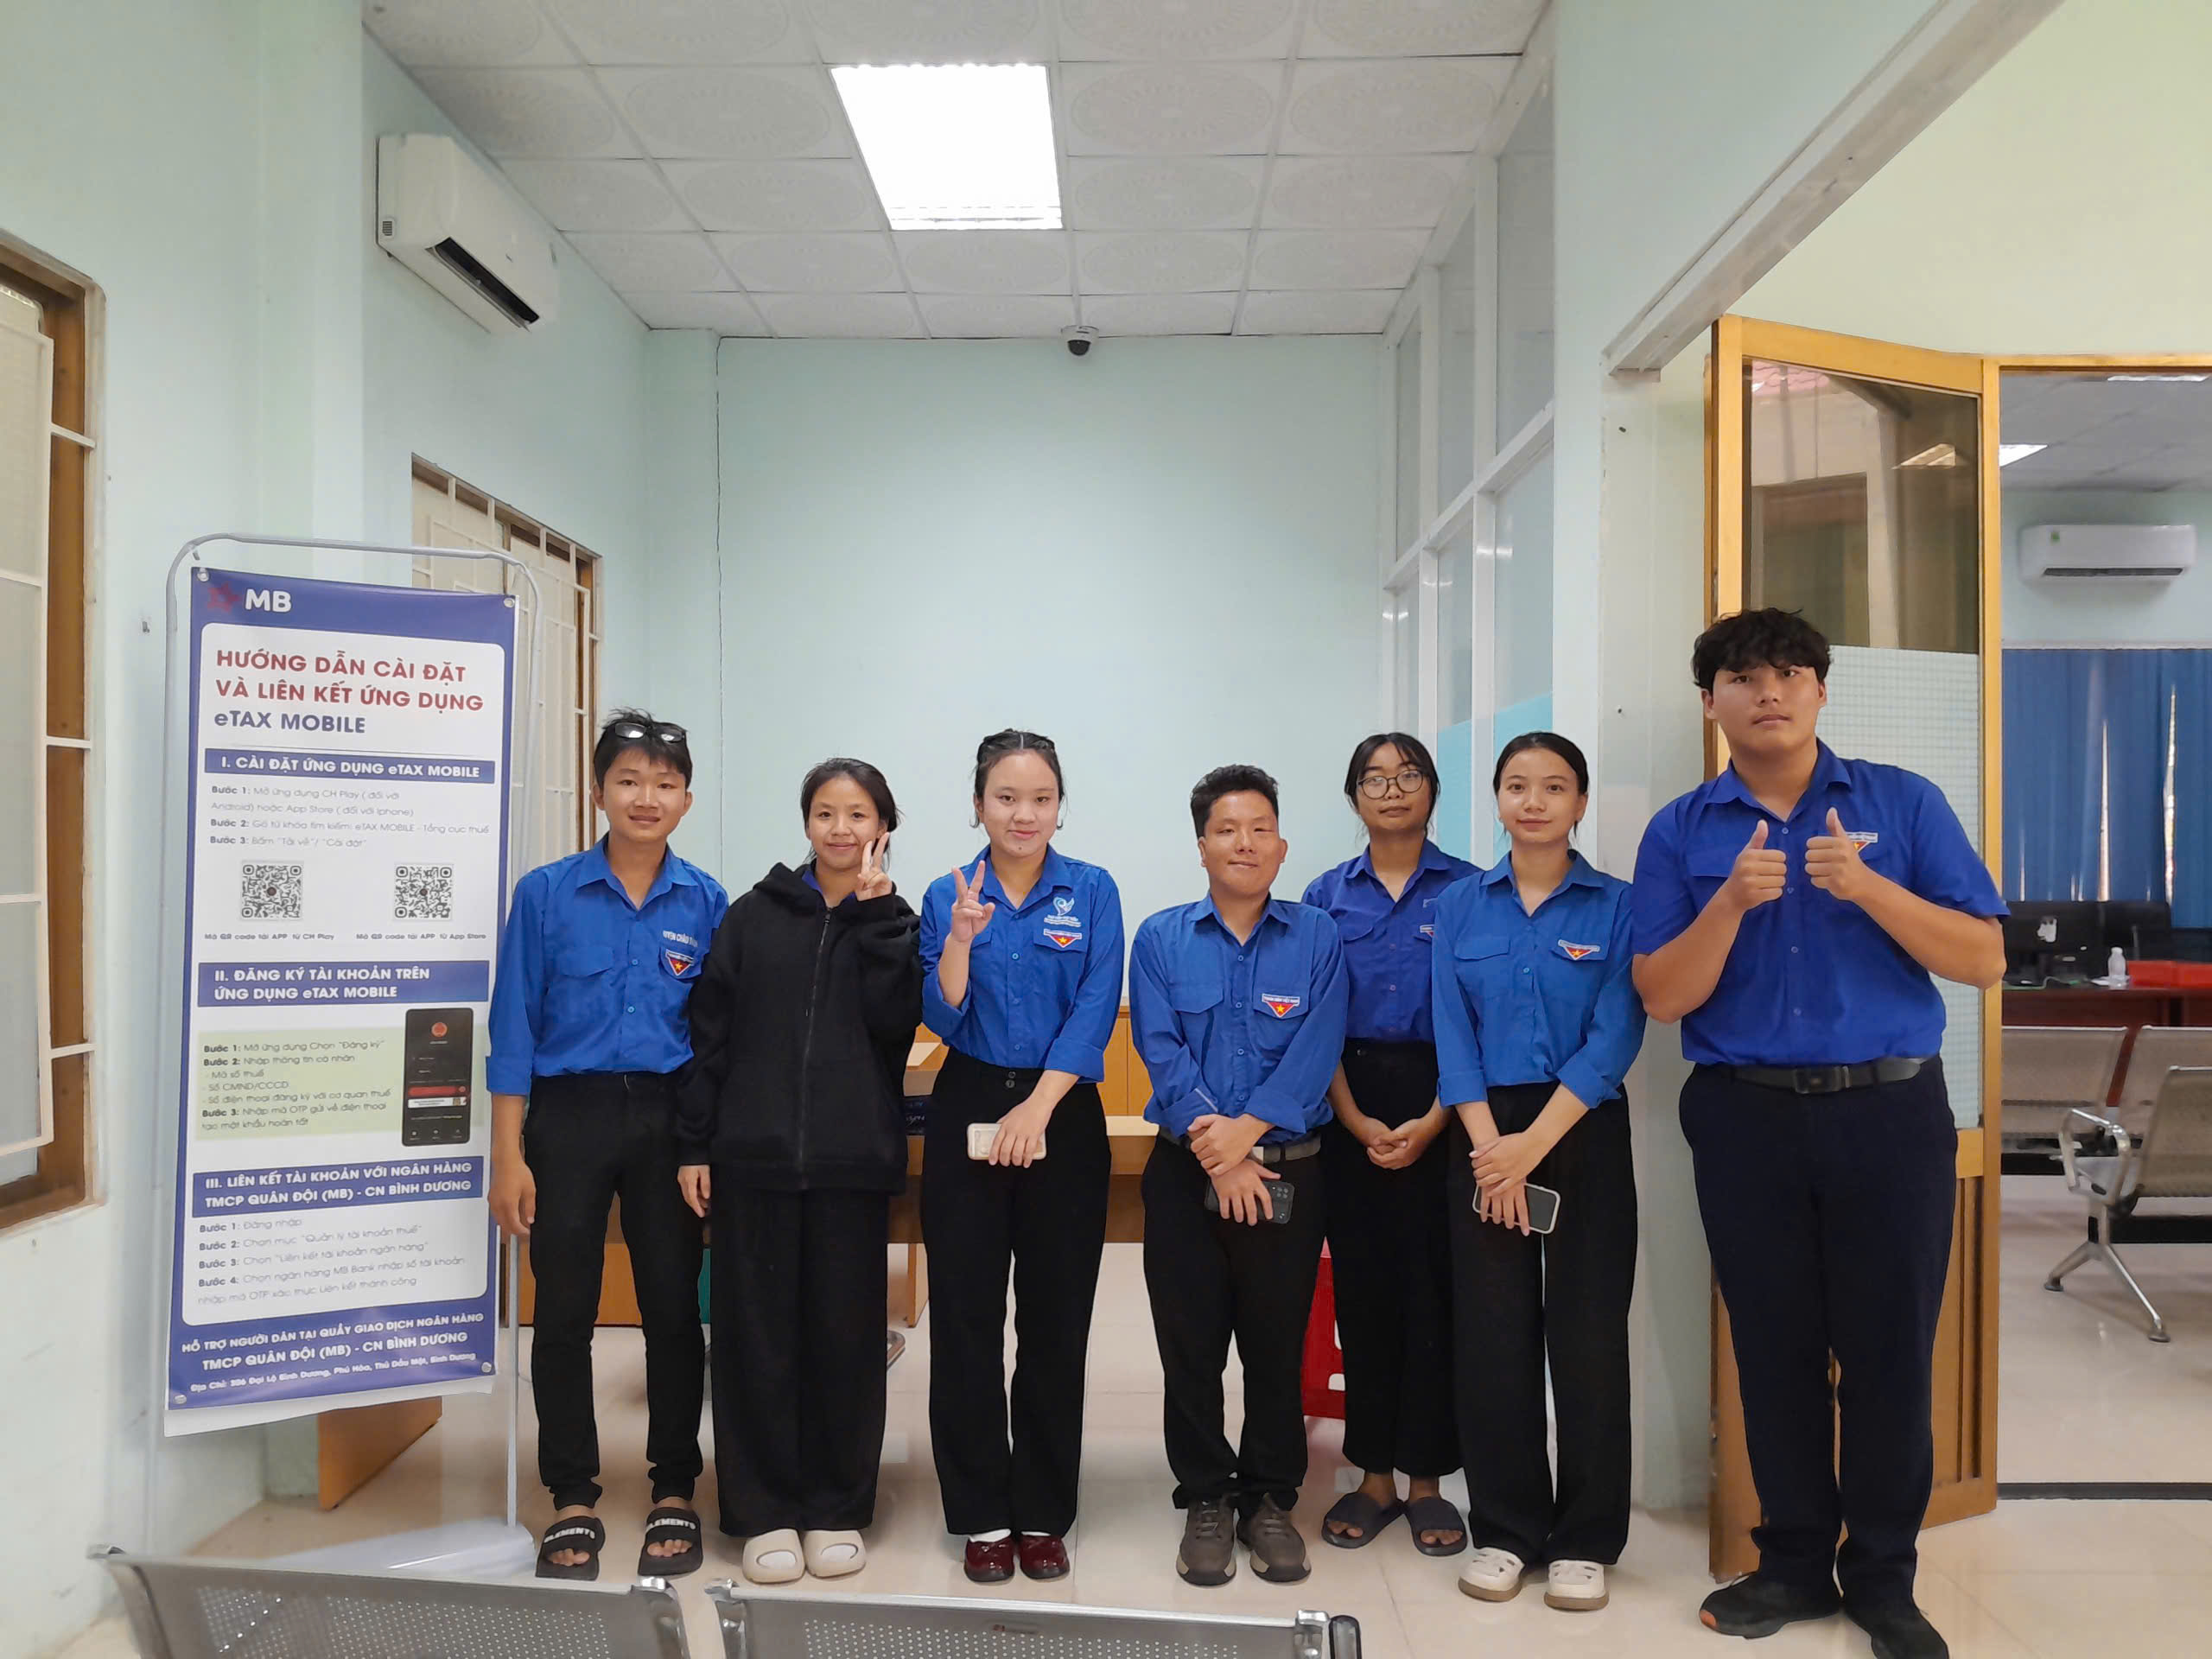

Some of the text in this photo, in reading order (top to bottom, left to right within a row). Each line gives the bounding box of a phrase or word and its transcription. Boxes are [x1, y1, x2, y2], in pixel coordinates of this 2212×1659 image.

[245, 589, 292, 613] MB
[216, 650, 467, 687] HƯỚNG DẪN CÀI ĐẶT
[216, 676, 484, 714] VÀ LIÊN KẾT ỨNG DỤNG
[214, 711, 365, 734] eTAX MOBILE
[221, 754, 480, 778] I. CÀI ĐẶT ỨNG DỤNG eTAX MOBILE
[214, 965, 429, 982] II. ĐĂNG KÝ TÀI KHOẢN TRÊN
[214, 985, 397, 1002] ỨNG DỤNG eTAX MOBILE
[205, 1161, 472, 1189] III. LIÊN KẾT TÀI KHOẢN VỚI NGÂN HÀNG
[205, 1180, 472, 1208] TMCP QUÂN ĐỘI (MB) CN BÌNH DƯƠNG
[181, 1313, 484, 1353] HỖ TRỢ NGƯỜI DÂN TẠI QUẦY GIAO DỊCH NGÂN HÀNG
[202, 1332, 467, 1370] TMCP QUÂN ĐỘI (MB) CN BÌNH DƯƠNG
